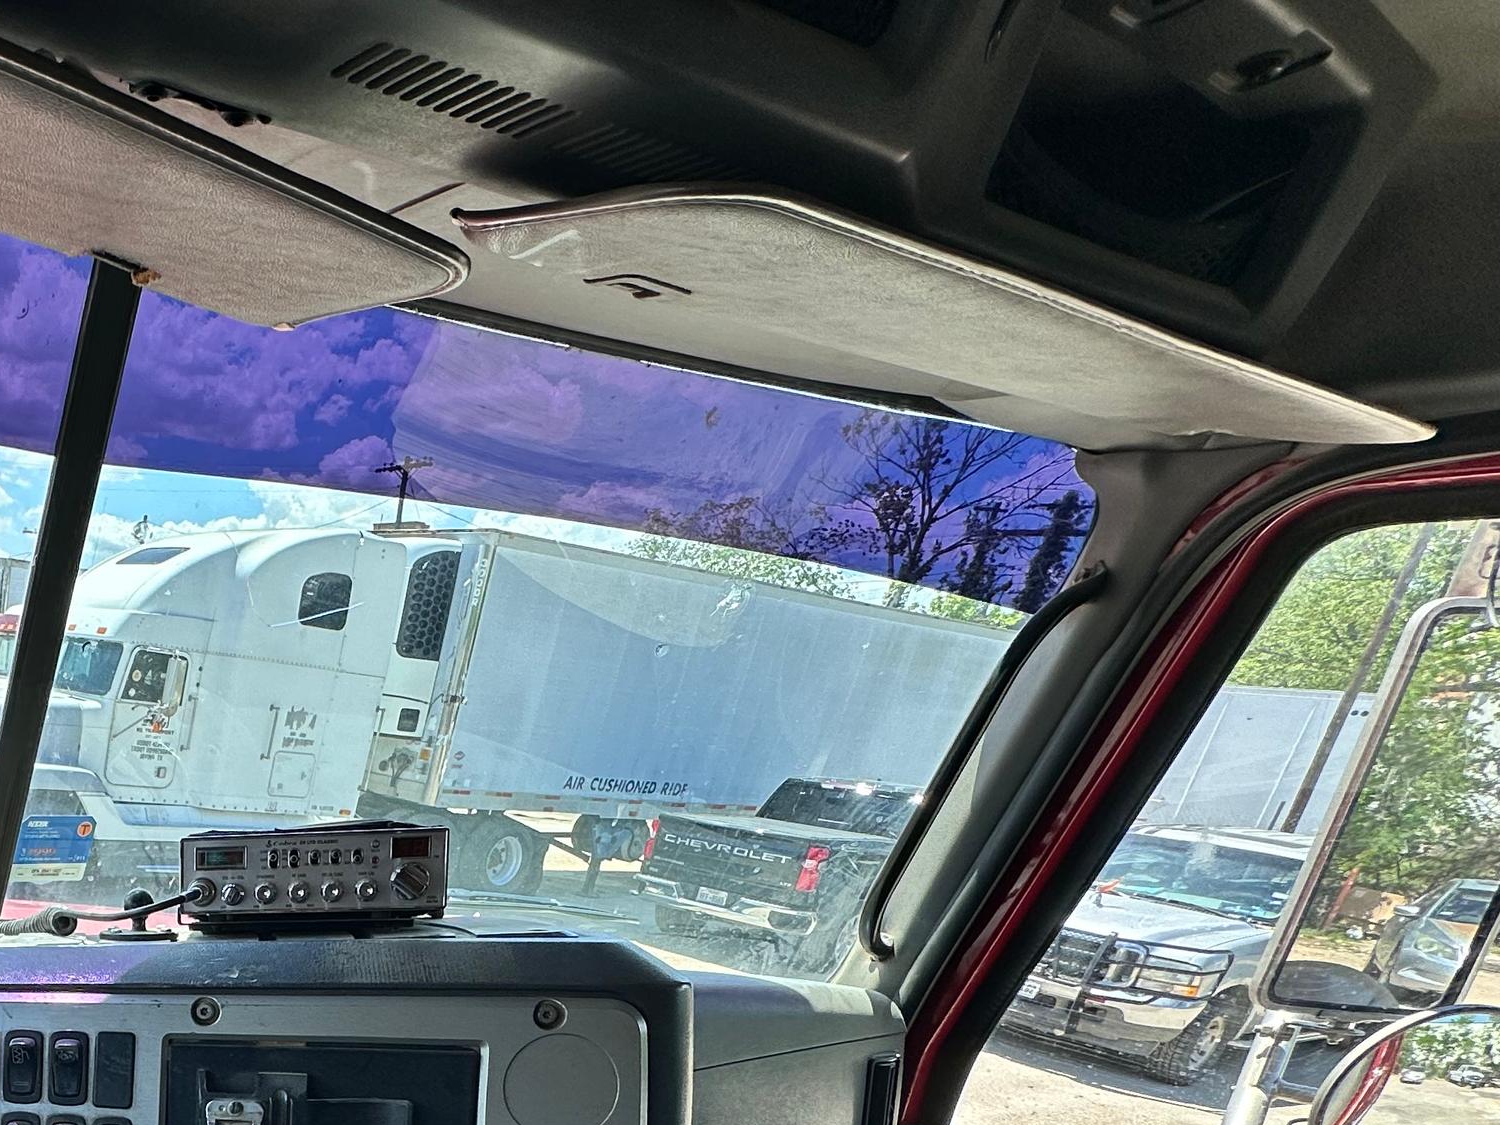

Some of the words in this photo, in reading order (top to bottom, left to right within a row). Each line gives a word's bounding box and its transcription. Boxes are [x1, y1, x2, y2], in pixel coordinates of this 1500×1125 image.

[563, 776, 586, 790] AIR
[590, 777, 657, 794] CUSHIONED
[664, 833, 793, 865] CHEVROLET
